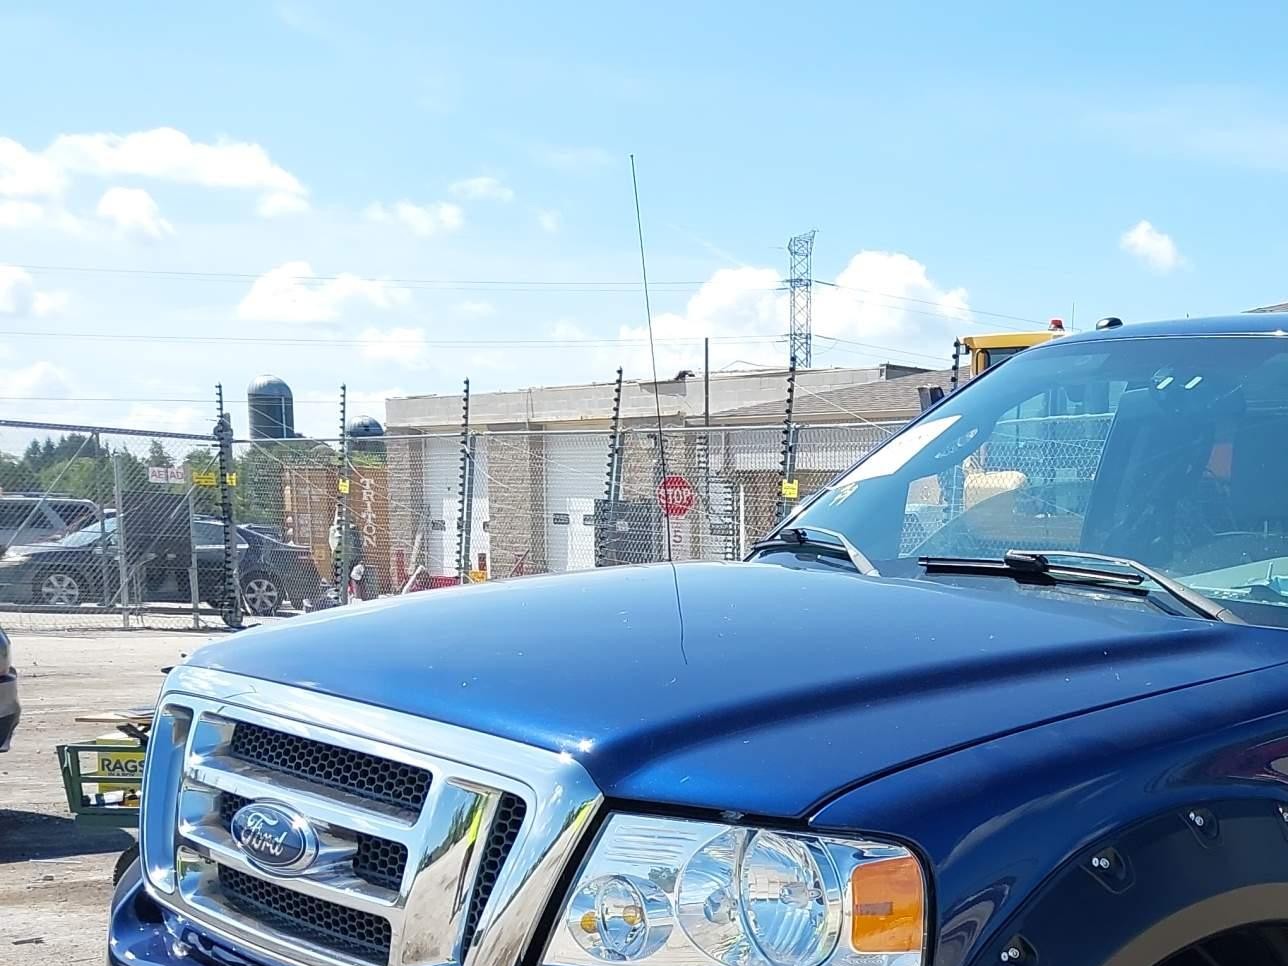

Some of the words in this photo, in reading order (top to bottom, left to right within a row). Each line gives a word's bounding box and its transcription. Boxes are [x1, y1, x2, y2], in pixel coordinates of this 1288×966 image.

[361, 478, 377, 547] TRITON
[660, 488, 692, 505] STOP
[241, 812, 288, 857] Ford
